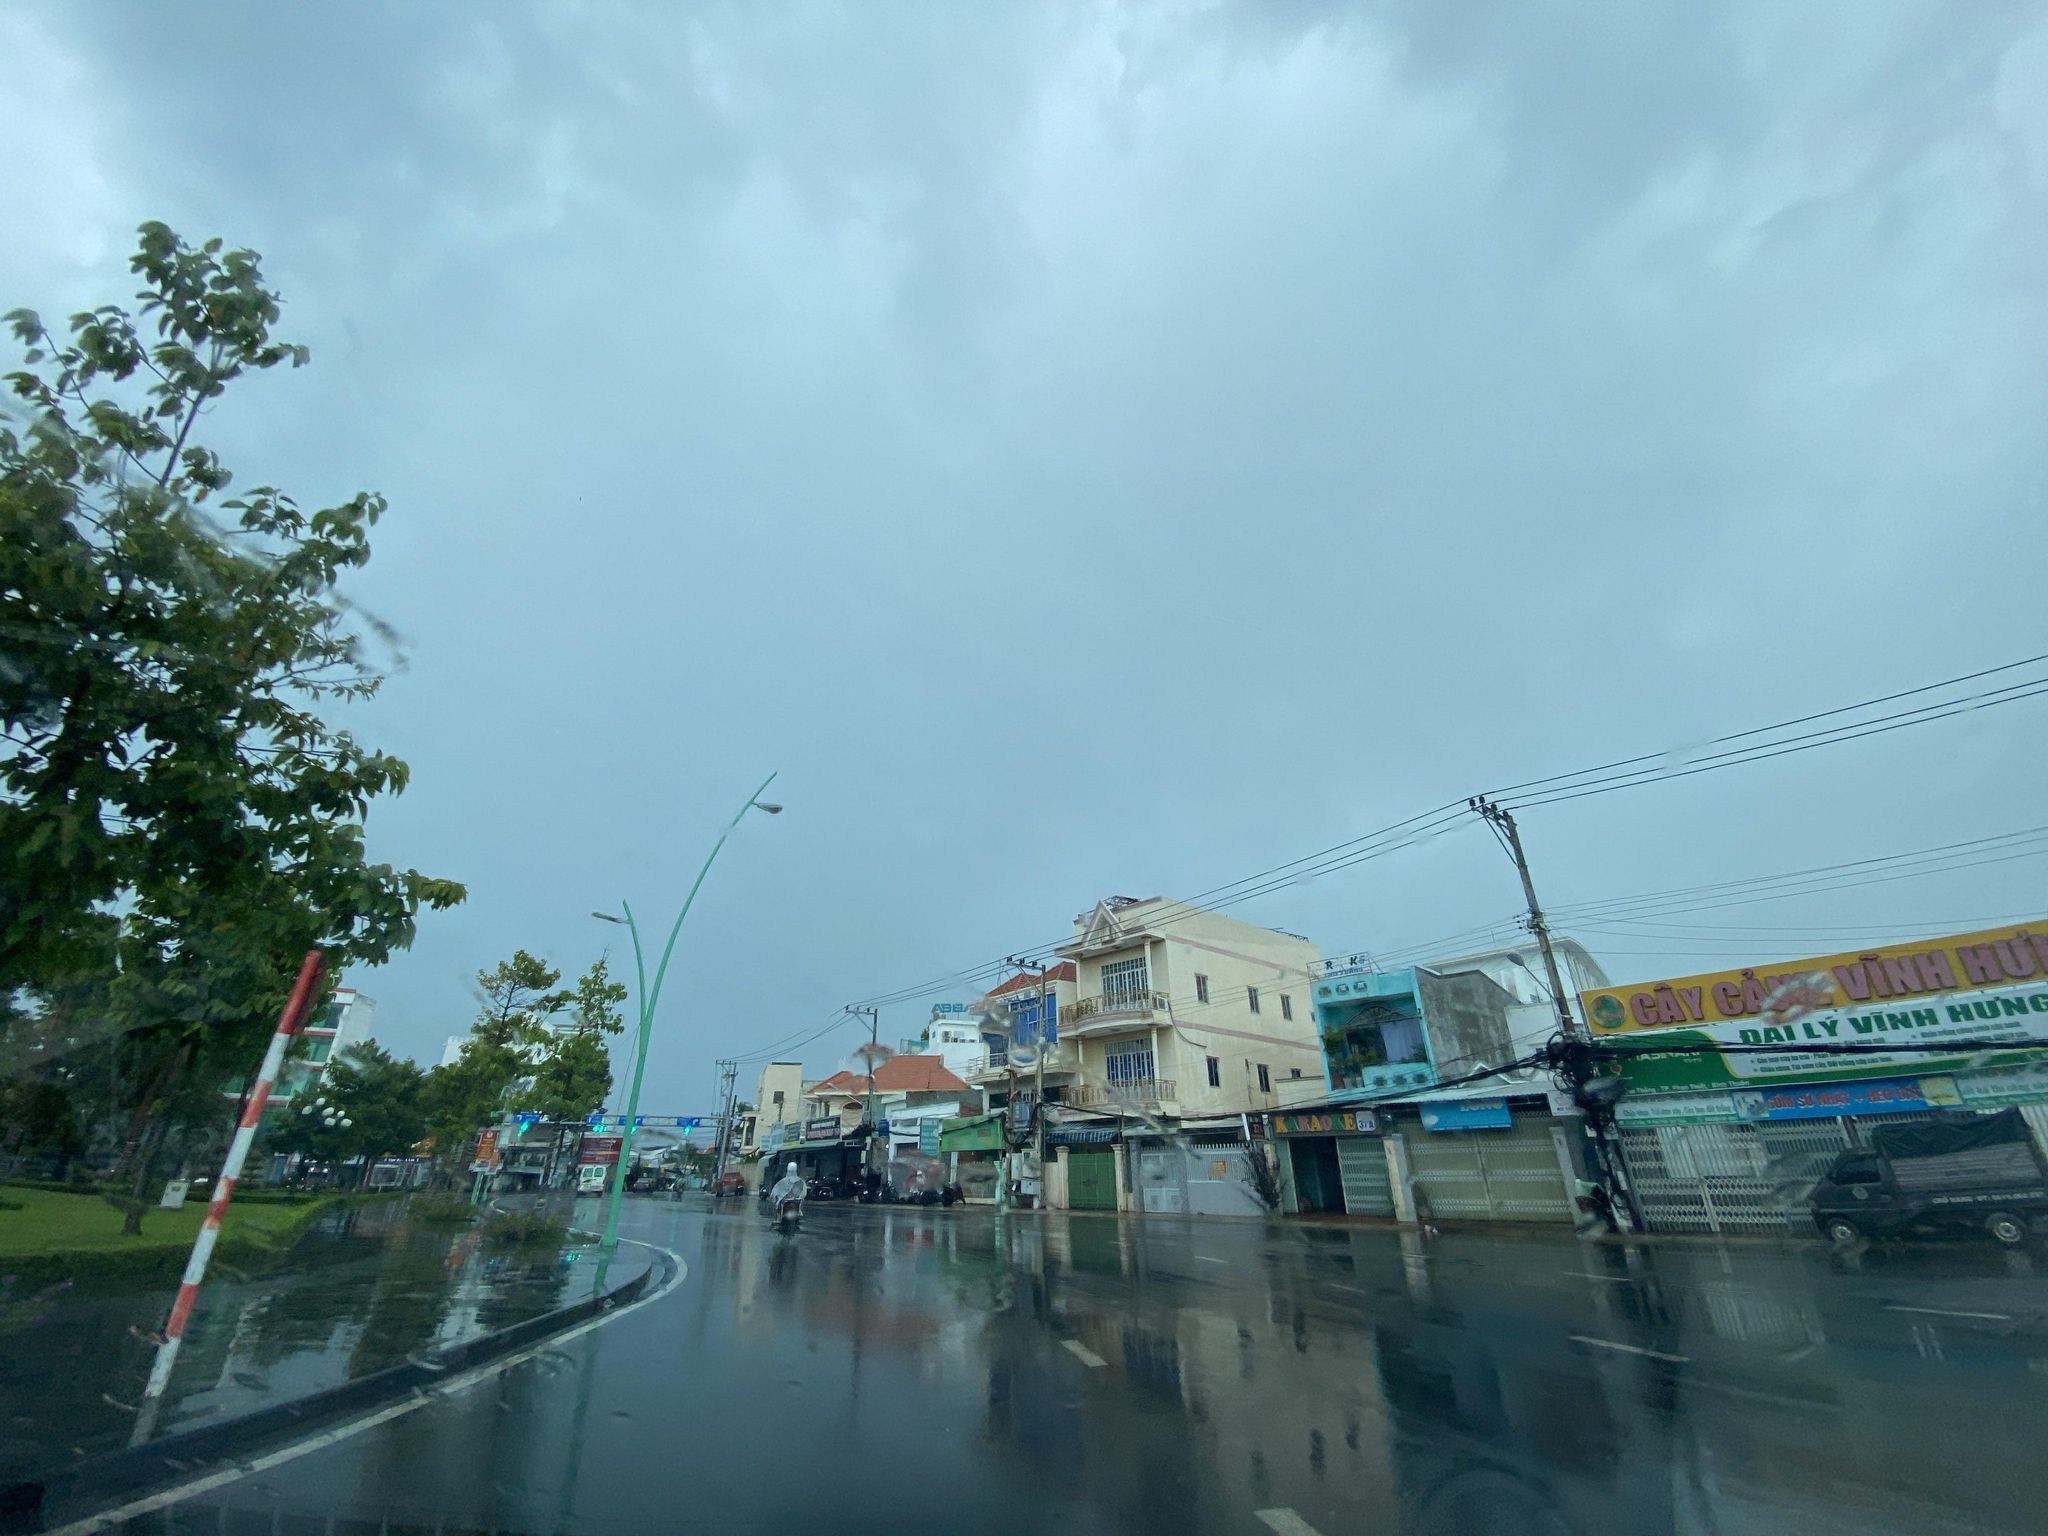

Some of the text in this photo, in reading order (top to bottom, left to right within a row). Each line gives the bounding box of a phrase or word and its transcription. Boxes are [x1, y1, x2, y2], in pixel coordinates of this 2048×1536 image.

[1630, 982, 1704, 1026] CÂY
[1711, 967, 1833, 1017] CẢN
[1832, 949, 1956, 1000] VĨNH
[1802, 1015, 1838, 1039] LÝ
[1847, 1008, 1940, 1034] VĨNH
[1945, 993, 2048, 1023] HƯNG
[1275, 1112, 1356, 1133] KARAOKE
